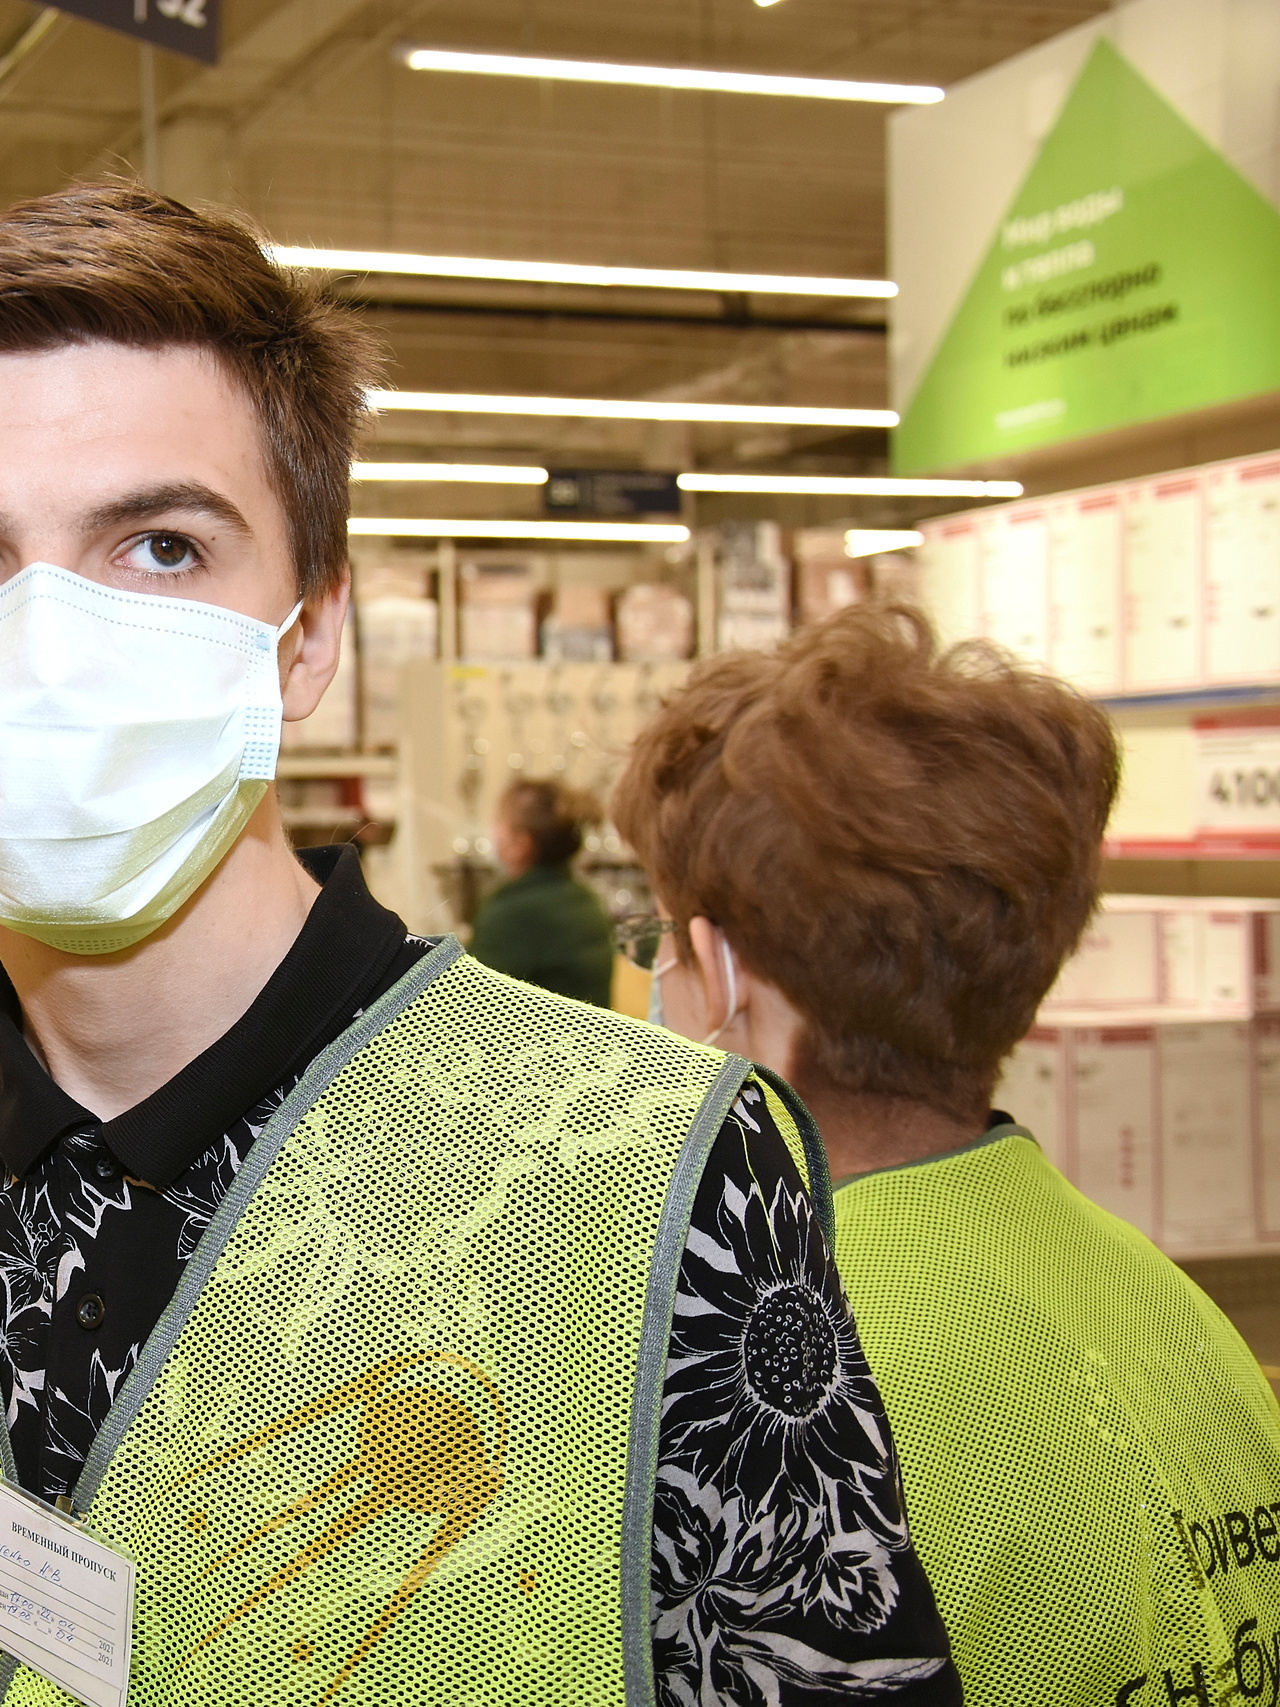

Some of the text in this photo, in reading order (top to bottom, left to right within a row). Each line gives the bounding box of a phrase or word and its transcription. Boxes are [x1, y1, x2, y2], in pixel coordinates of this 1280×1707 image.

[11, 1521, 117, 1582] ВРЕМЕННЫЙ ПРОПУСК
[98, 1640, 115, 1655] 2021
[97, 1652, 113, 1667] 2021
